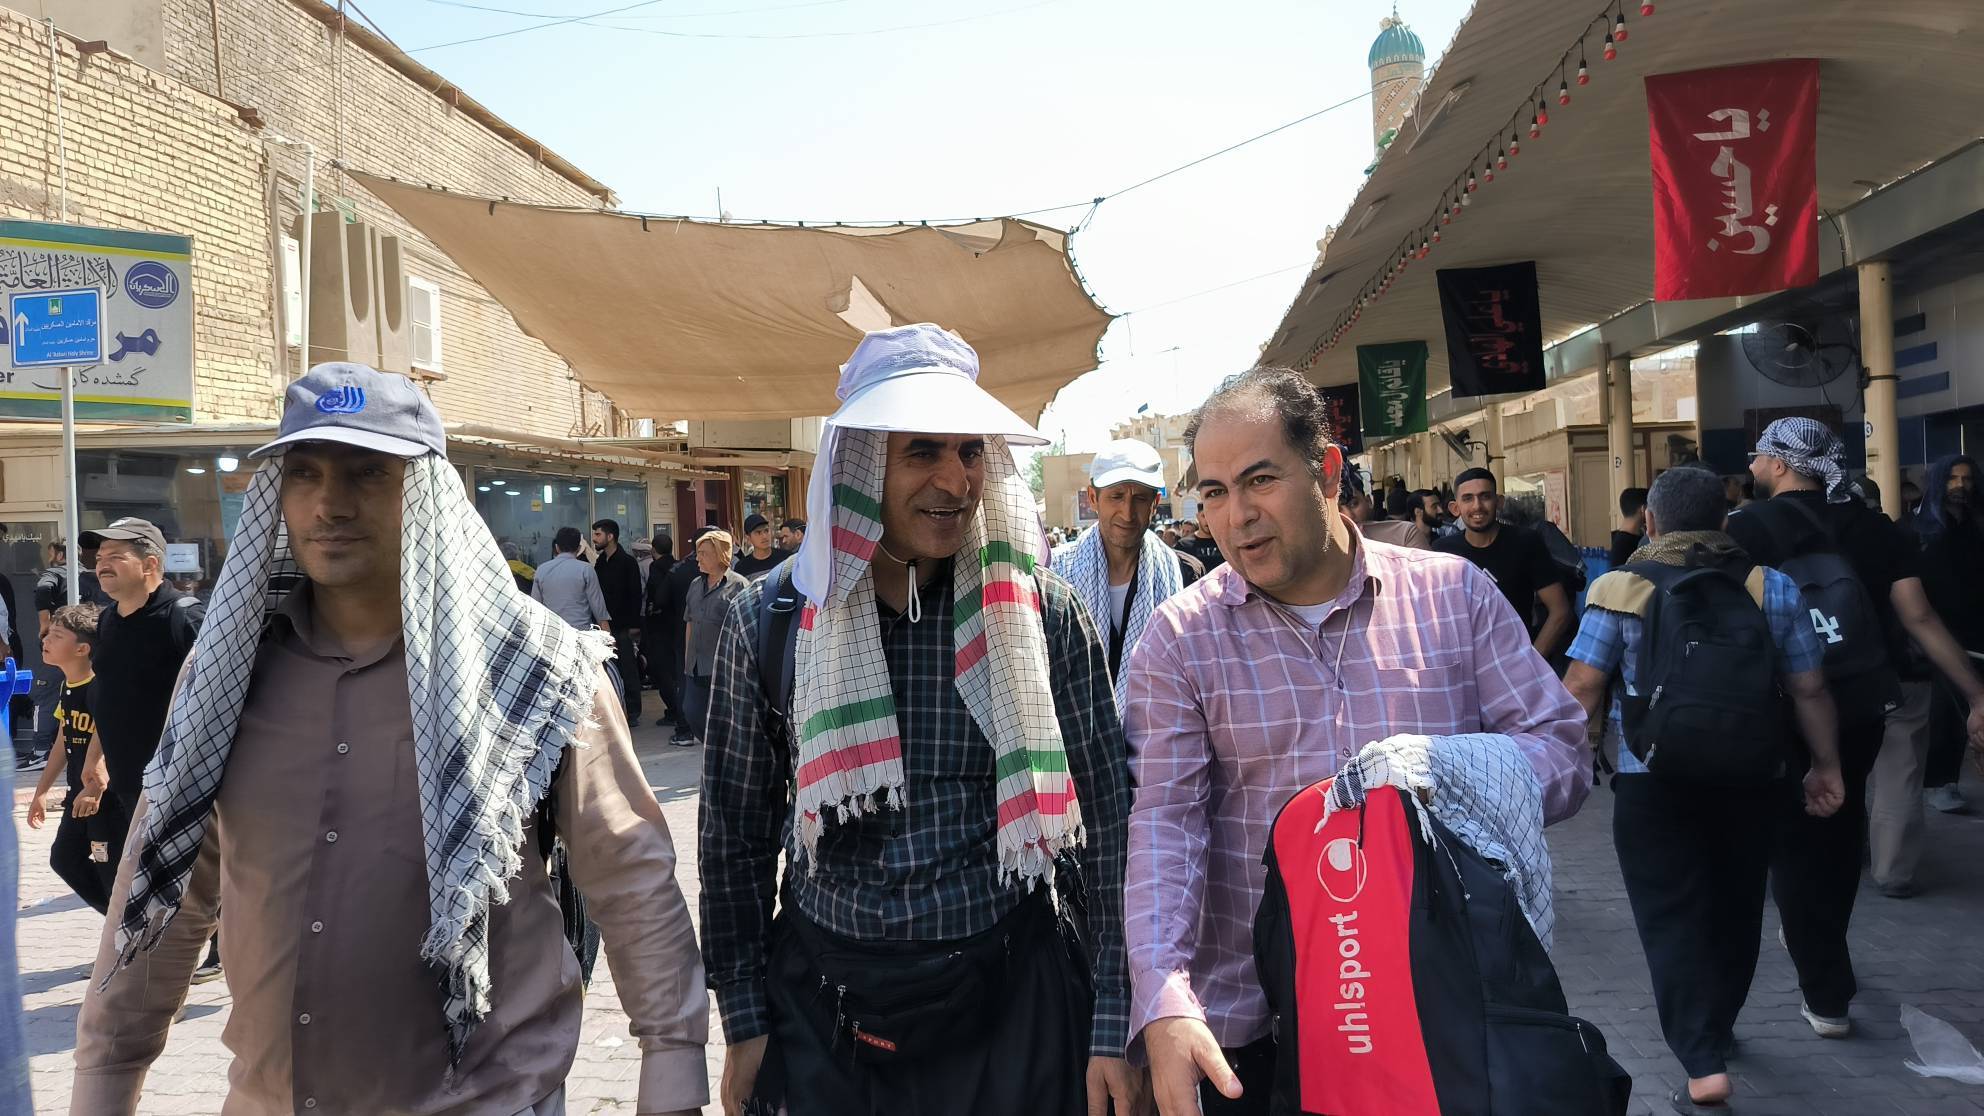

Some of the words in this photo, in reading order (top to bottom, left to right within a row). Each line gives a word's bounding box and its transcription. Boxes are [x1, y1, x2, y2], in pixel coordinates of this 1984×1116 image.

[1693, 108, 1771, 142] يا
[1706, 145, 1779, 255] حسين
[1327, 910, 1374, 1054] uhlsport
